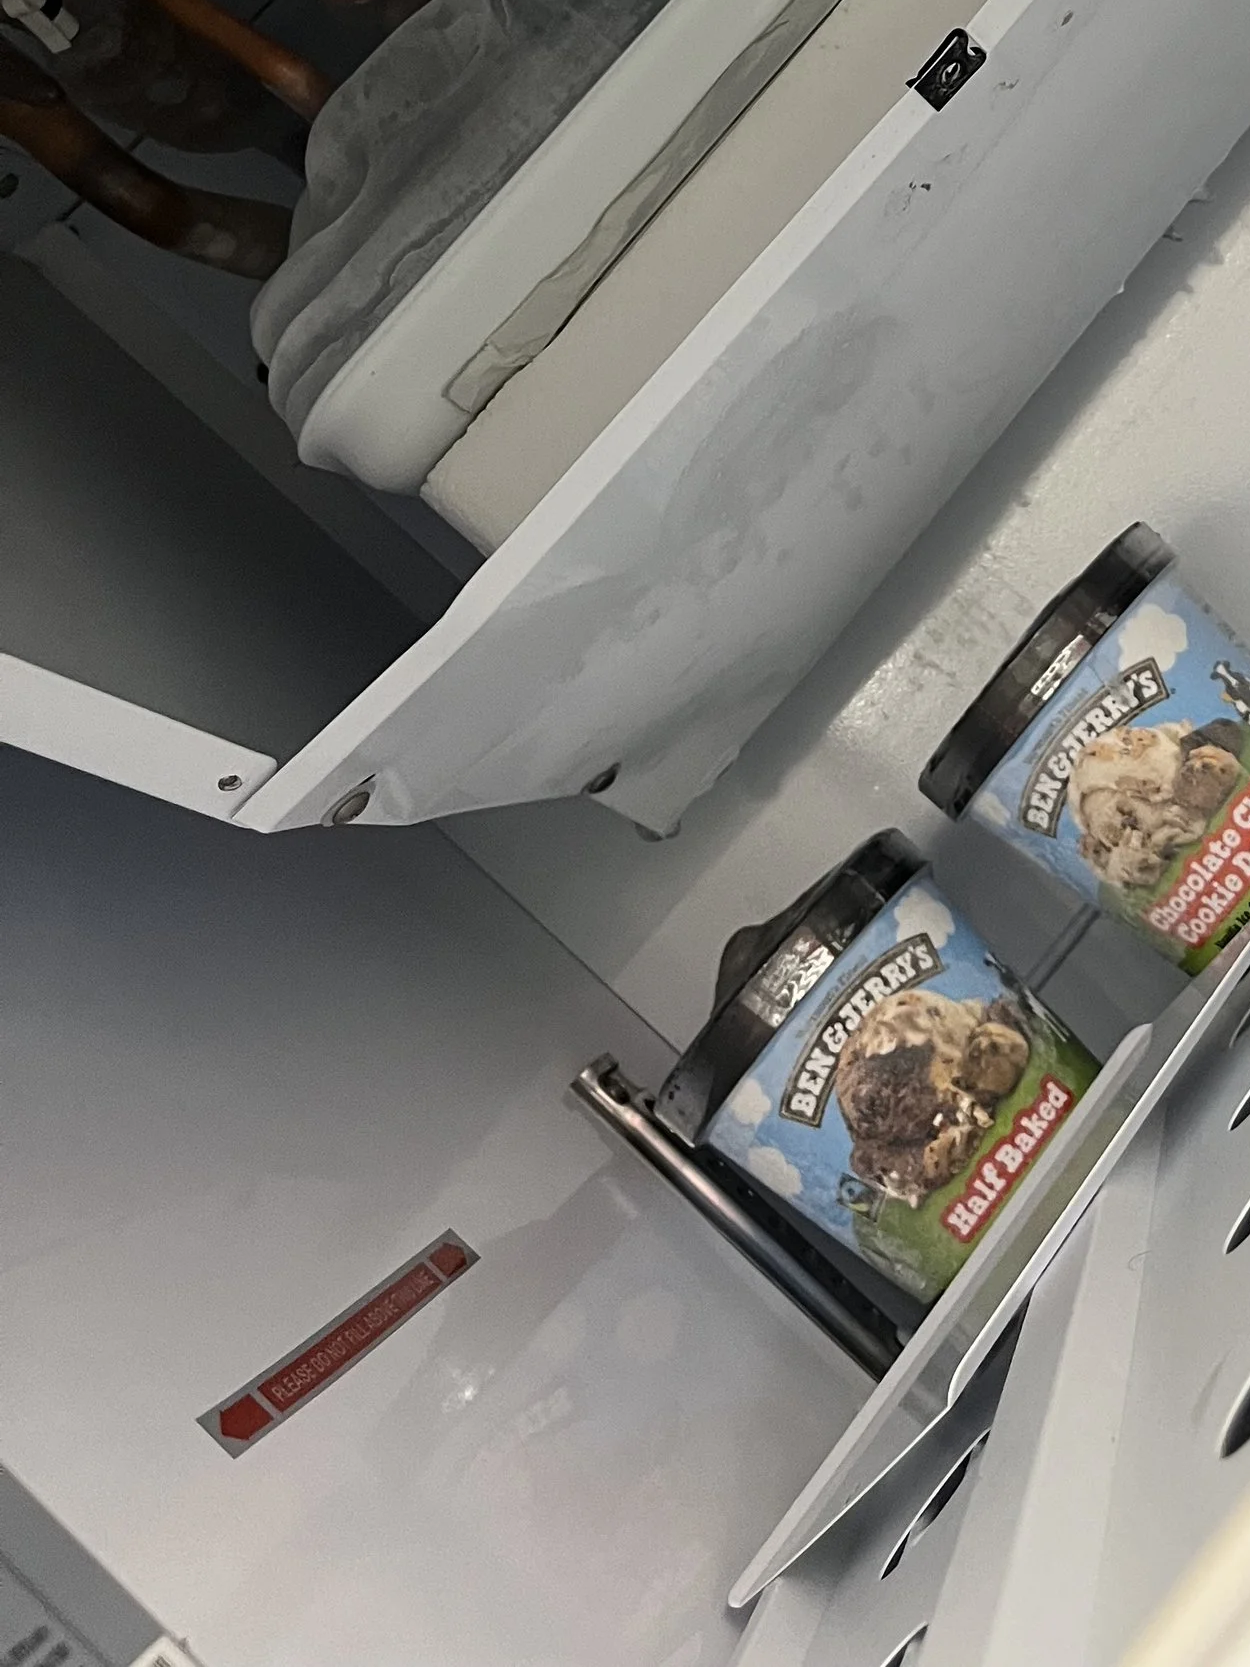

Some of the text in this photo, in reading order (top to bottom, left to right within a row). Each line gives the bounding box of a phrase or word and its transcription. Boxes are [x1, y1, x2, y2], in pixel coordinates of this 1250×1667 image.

[1026, 778, 1062, 830] BEN
[1149, 827, 1242, 932] Chocolate
[1176, 872, 1245, 946] Cookie
[790, 1049, 836, 1118] BEN
[842, 943, 935, 1032] JERRY'S
[945, 1081, 1071, 1237] Half Baked
[272, 1363, 316, 1403] PLEASE
[310, 1352, 331, 1373] DO
[328, 1337, 348, 1360] NOT
[345, 1322, 369, 1345] FILL
